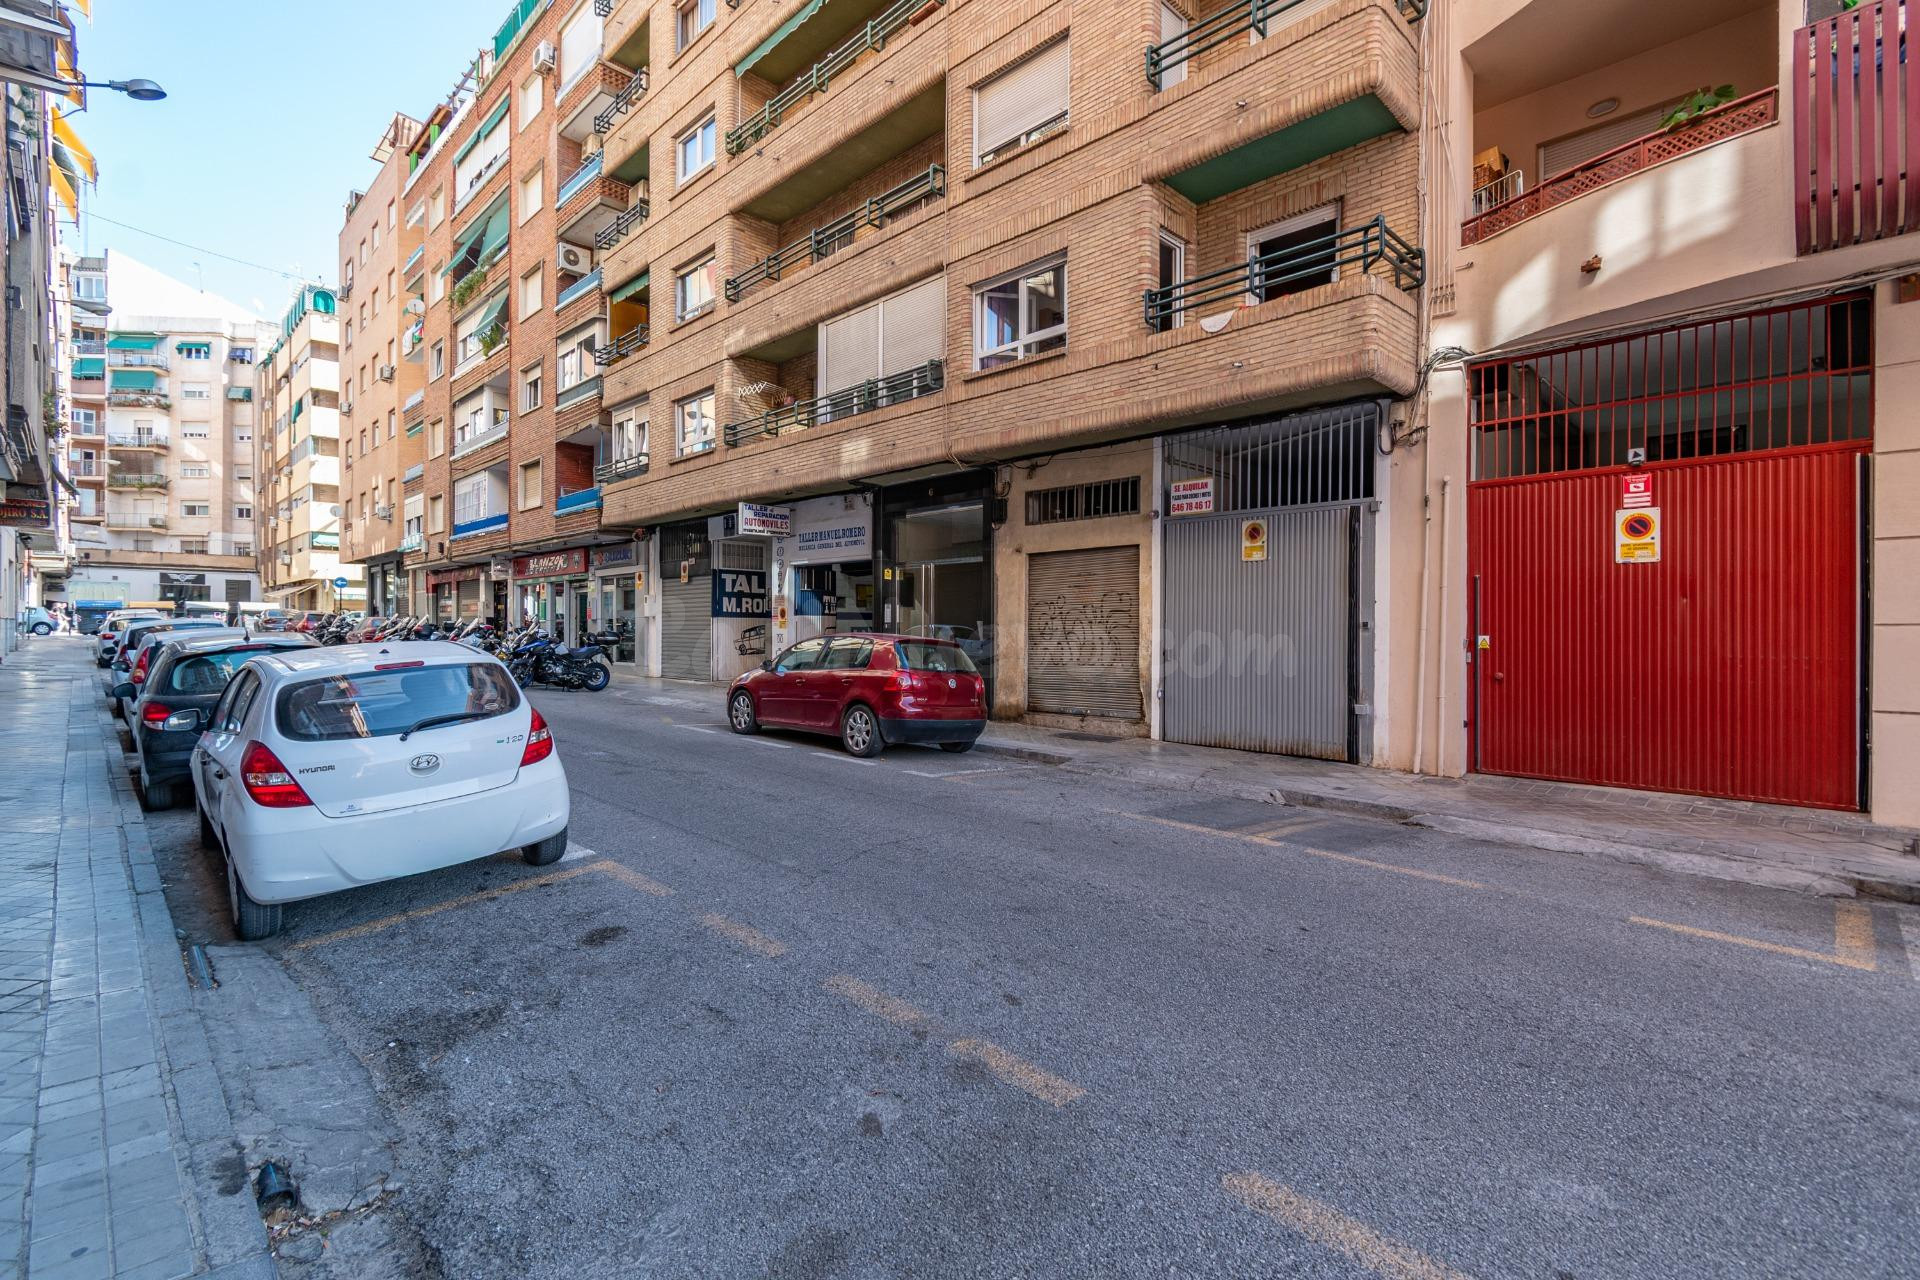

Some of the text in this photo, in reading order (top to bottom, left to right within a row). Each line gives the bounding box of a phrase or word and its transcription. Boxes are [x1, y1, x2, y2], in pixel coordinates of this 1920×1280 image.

[744, 504, 768, 512] TALLER
[1172, 503, 1184, 512] 646
[1194, 501, 1203, 510] 46
[1204, 500, 1211, 509] 17
[744, 517, 789, 530] AUTOMOVILES
[798, 526, 866, 543] TALLER MANUEL ROMERO
[605, 548, 632, 562] SUZUKI
[721, 573, 765, 594] TAL
[722, 596, 766, 613] M.RO
[299, 765, 335, 774] HYUNDAI
